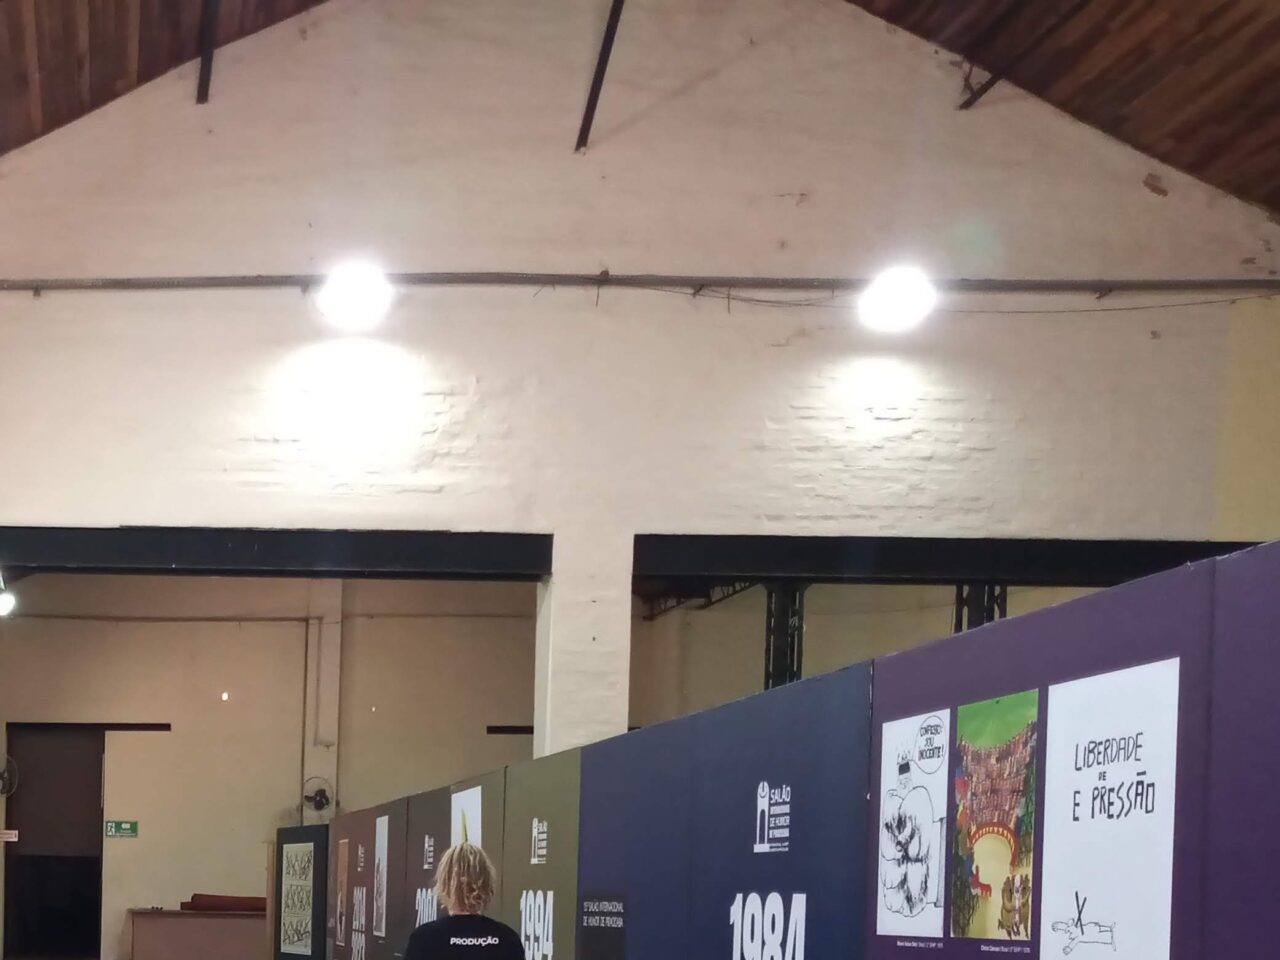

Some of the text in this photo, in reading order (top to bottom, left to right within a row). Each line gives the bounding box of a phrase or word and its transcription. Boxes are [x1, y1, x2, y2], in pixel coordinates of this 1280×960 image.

[1074, 732, 1144, 771] LIBERDADE
[1098, 771, 1107, 781] DE
[770, 784, 791, 804] SALÃO
[1072, 770, 1155, 822] E PRESSÃO
[450, 936, 500, 947] PRODUÇÃO
